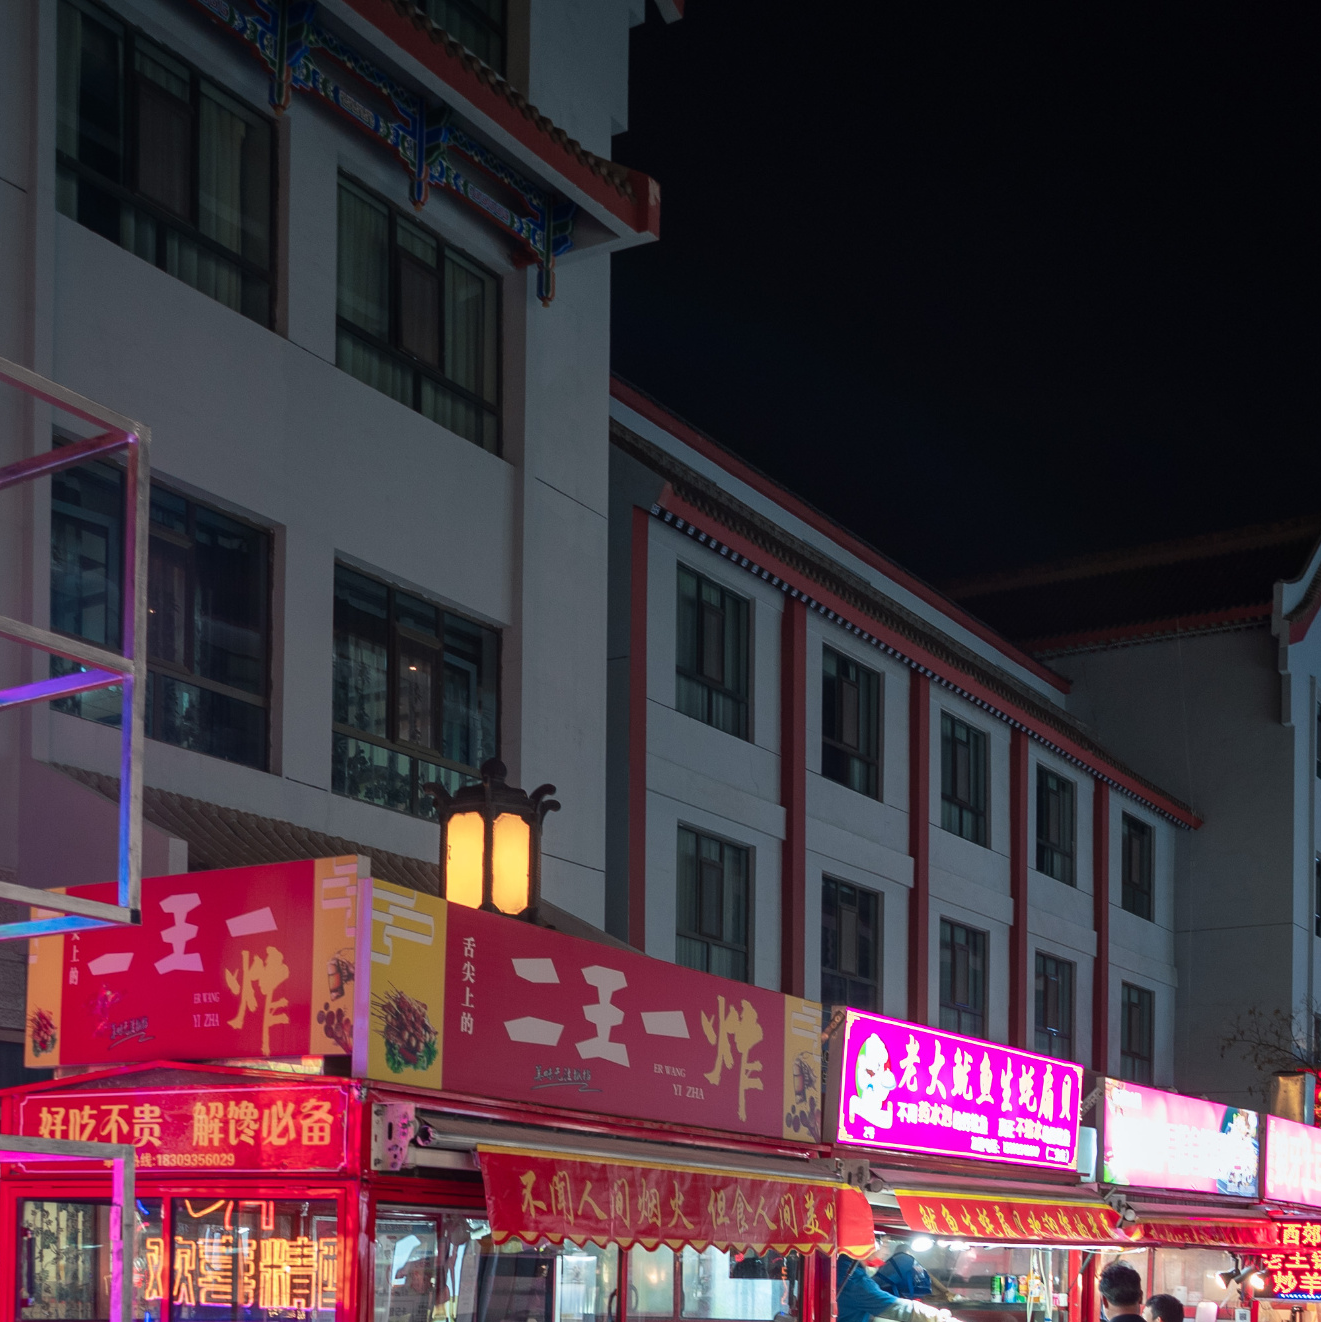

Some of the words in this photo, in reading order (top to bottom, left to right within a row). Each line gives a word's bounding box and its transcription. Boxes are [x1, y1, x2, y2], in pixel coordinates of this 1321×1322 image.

[459, 936, 477, 1036] 舌尖上的
[503, 957, 764, 1122] 二王一炸
[653, 1063, 664, 1074] ER
[664, 1065, 687, 1078] WANG
[672, 1084, 682, 1096] YI
[686, 1086, 705, 1100] ZHA
[39, 1103, 163, 1147] 好吃不贵
[192, 1098, 335, 1147] 解馋必备
